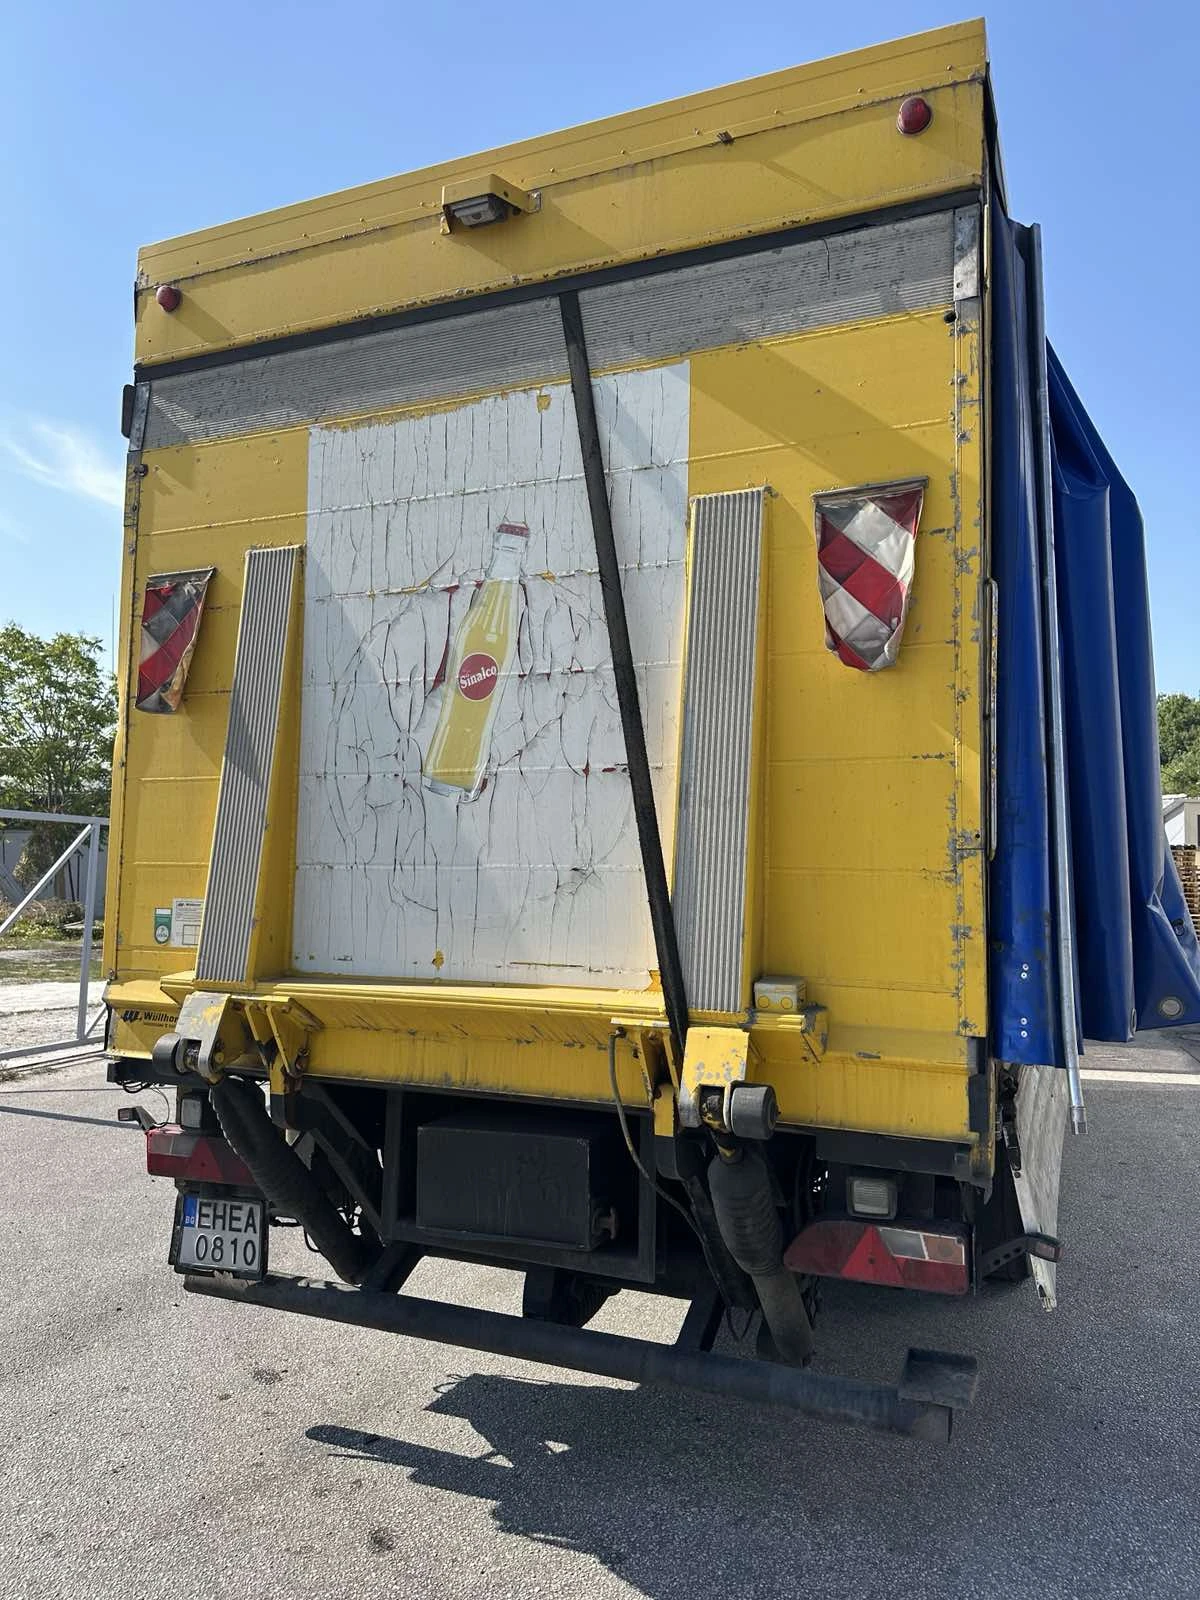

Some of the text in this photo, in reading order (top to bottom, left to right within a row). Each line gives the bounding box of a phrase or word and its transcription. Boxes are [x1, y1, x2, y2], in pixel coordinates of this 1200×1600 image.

[460, 666, 497, 689] Sinalco
[185, 1216, 195, 1225] BG
[198, 1201, 257, 1234] EHEA
[195, 1234, 256, 1266] 0810
